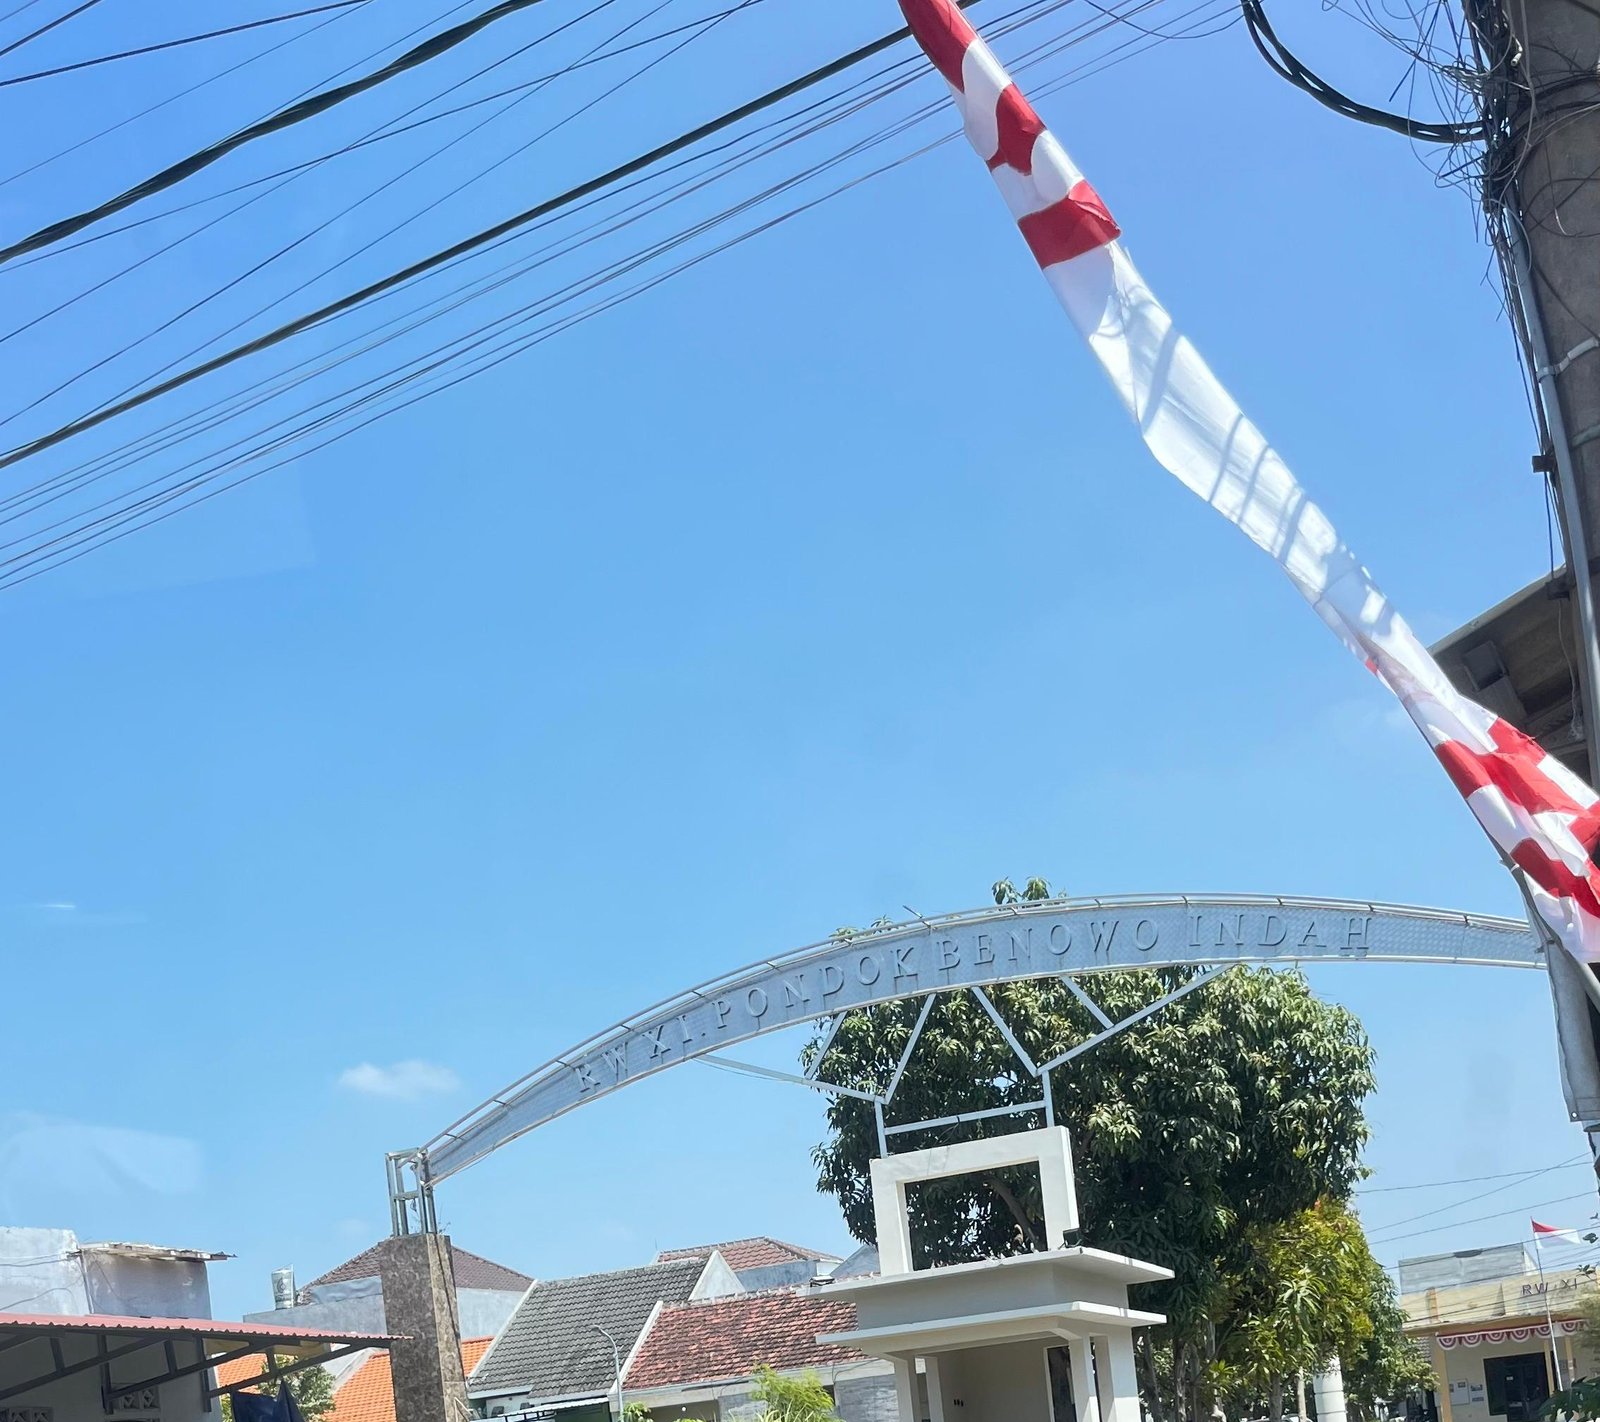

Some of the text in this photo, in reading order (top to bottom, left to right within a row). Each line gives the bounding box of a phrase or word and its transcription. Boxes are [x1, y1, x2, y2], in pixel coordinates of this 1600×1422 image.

[573, 1041, 629, 1093] RW
[711, 945, 919, 1030] PONDOK
[935, 917, 1160, 971] BENOWO
[1189, 912, 1373, 951] INDAH
[1522, 1281, 1549, 1296] RW
